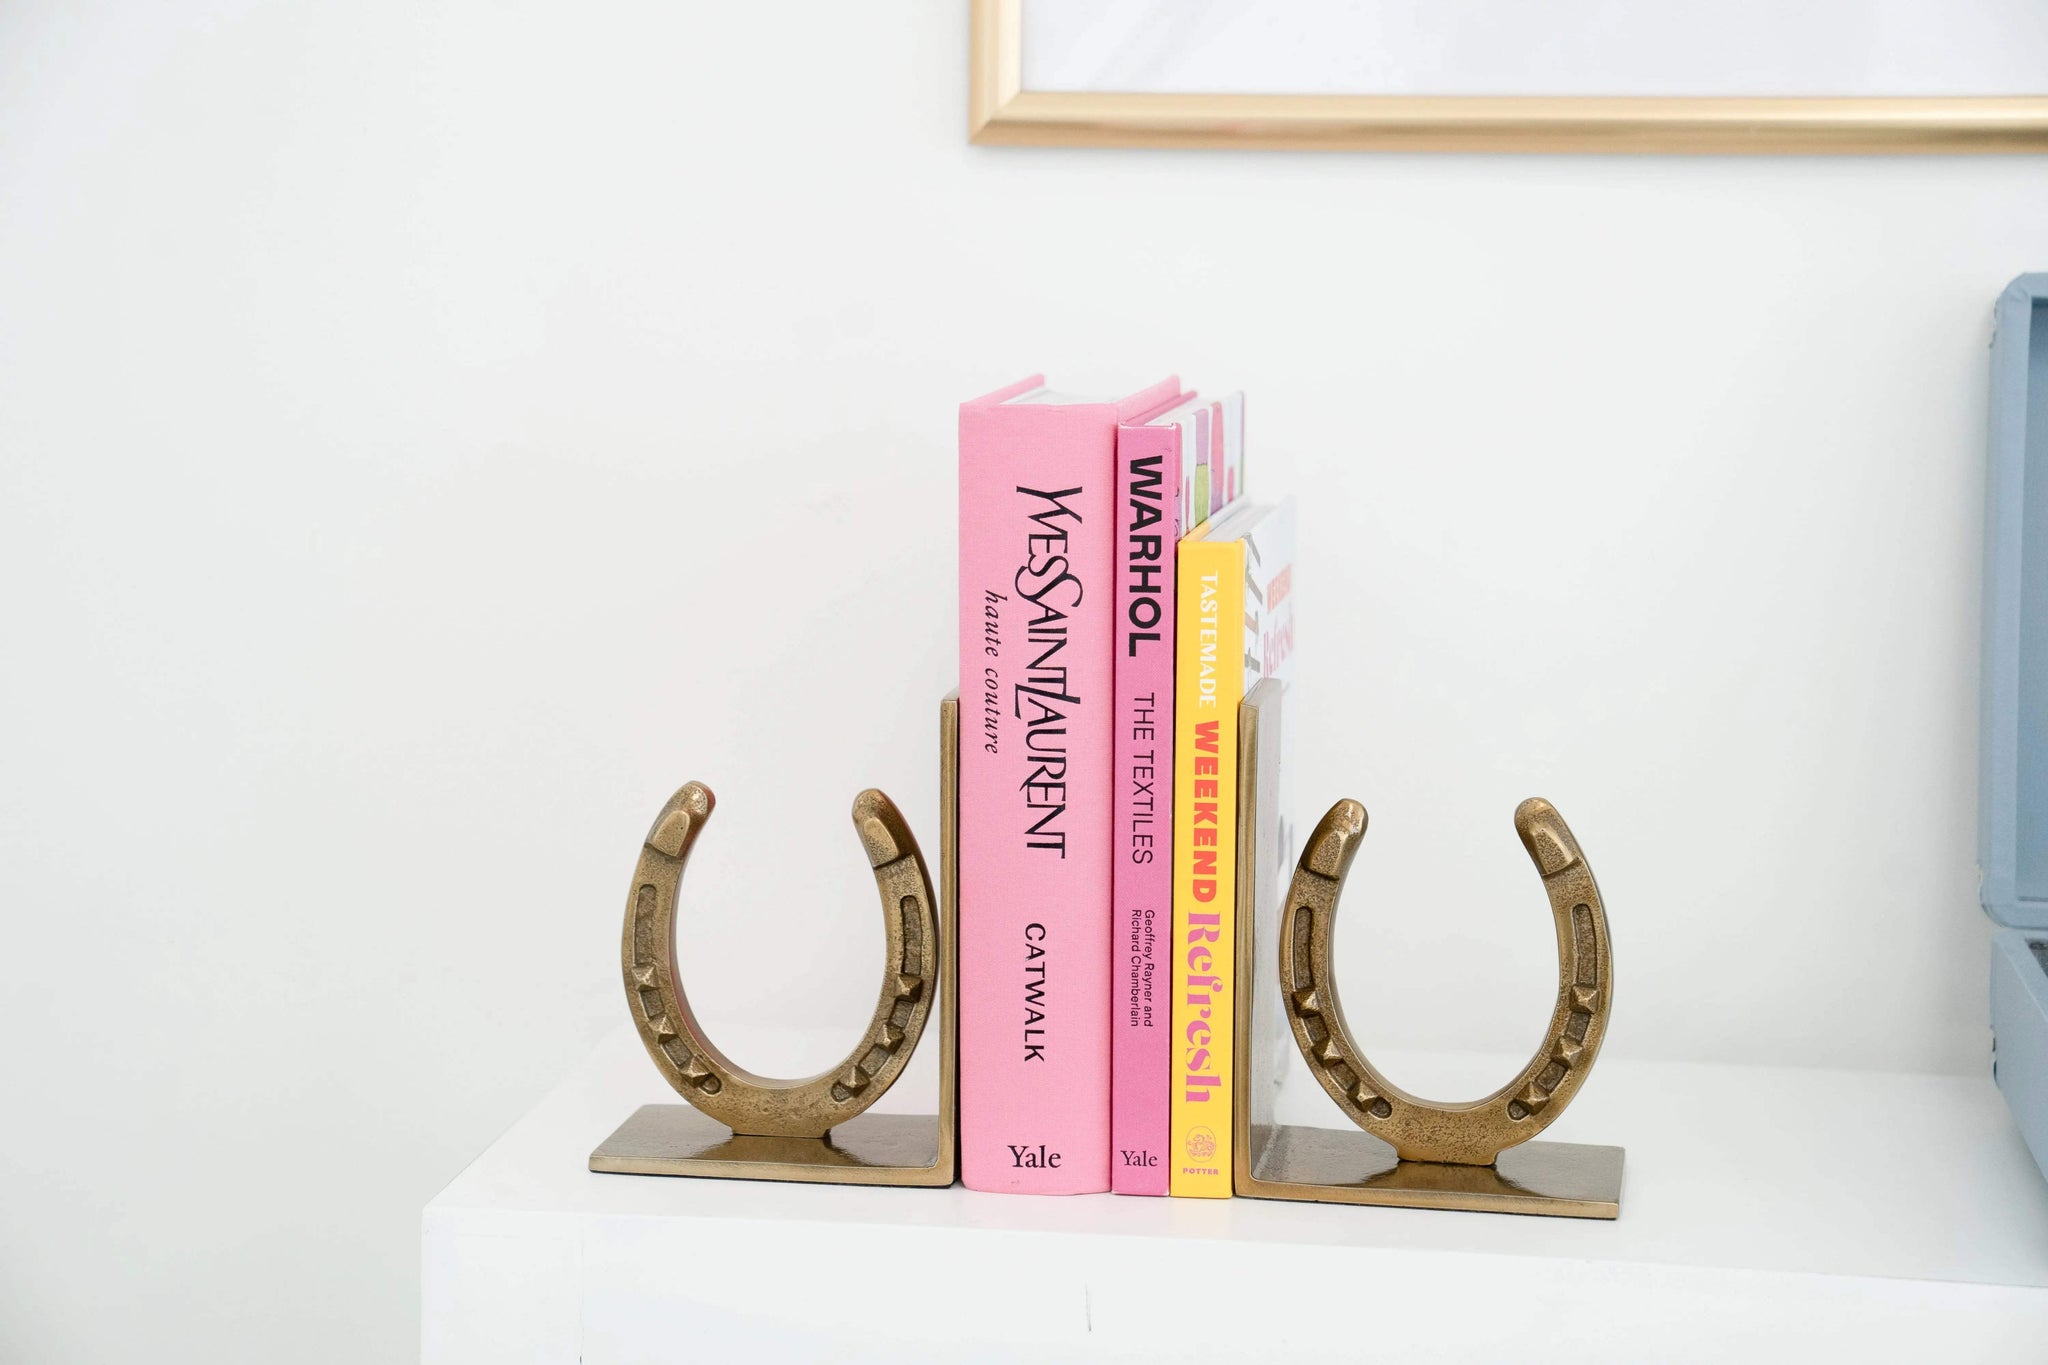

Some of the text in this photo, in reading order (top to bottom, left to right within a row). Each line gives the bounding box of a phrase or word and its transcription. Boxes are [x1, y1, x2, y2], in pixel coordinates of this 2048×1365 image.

[1128, 454, 1163, 658] WARHOL
[984, 589, 1008, 754] haute couture
[1132, 692, 1155, 865] THE TEXTILES
[1185, 571, 1223, 1103] TASTEMADE WEEKEND Refresh
[1024, 922, 1047, 1062] CATWALK
[1130, 909, 1142, 1027] Richard Chamberlain
[1142, 909, 1156, 1027] Geoffrey Rayner and
[1007, 1145, 1062, 1169] Yale
[1120, 1150, 1158, 1167] Yale
[1182, 1167, 1219, 1175] POTTER
